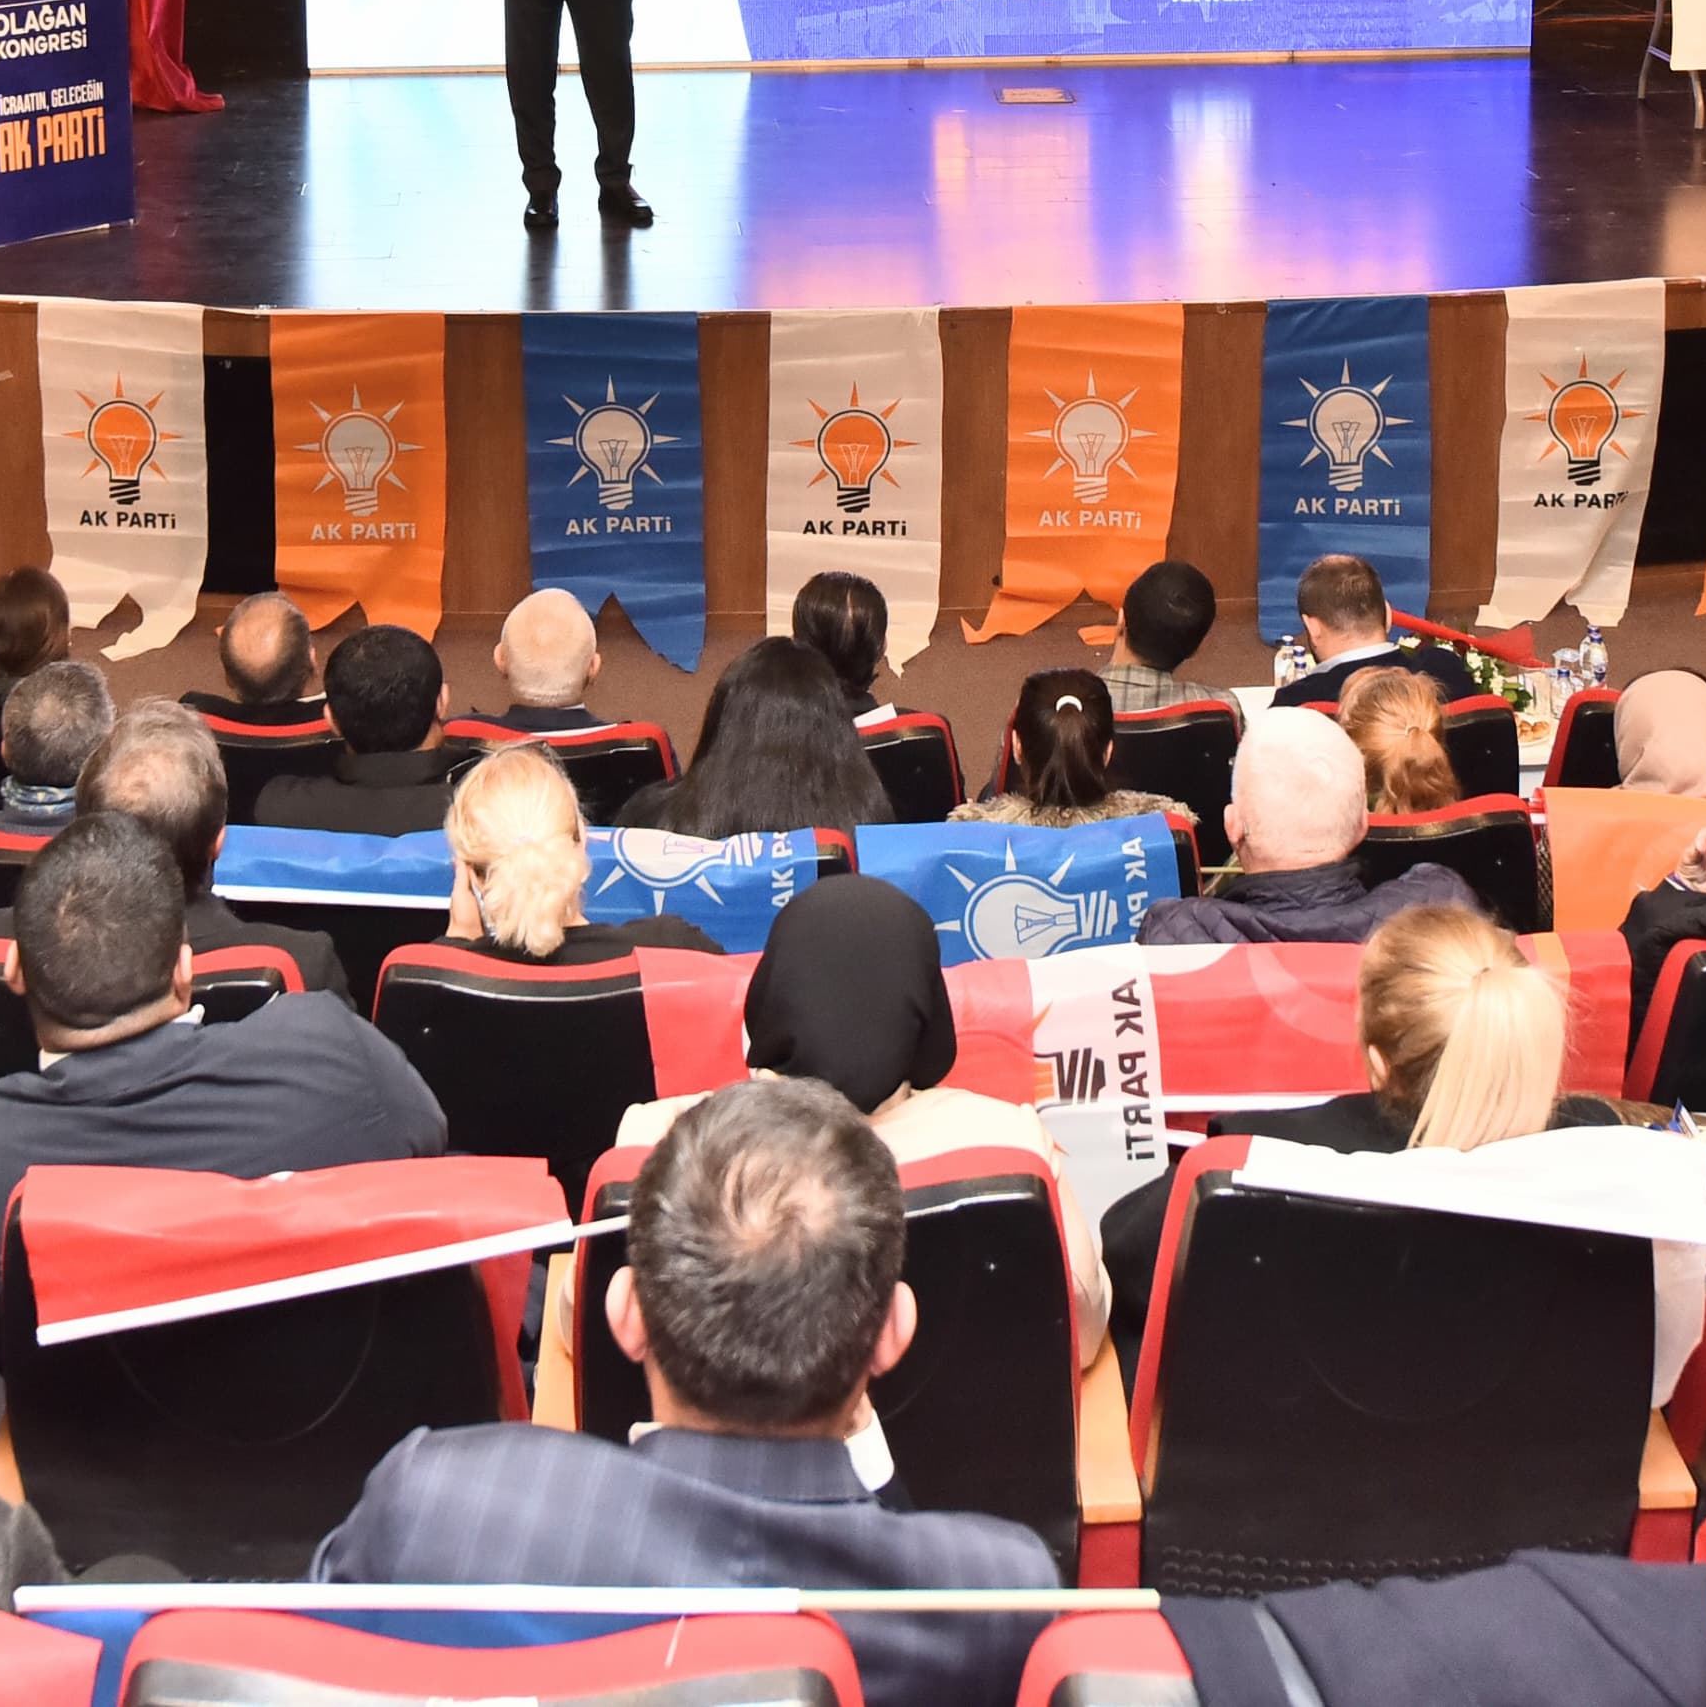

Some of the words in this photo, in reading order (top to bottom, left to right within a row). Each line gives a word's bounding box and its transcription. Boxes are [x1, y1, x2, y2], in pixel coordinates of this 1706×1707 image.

[50, 78, 104, 110] GELECEĞİN
[1294, 497, 1326, 516] AK
[1534, 493, 1565, 508] AK
[79, 510, 109, 528] AK
[564, 516, 598, 536] AK
[801, 519, 835, 537] AK
[1038, 509, 1071, 528] AK
[309, 523, 342, 542] AK
